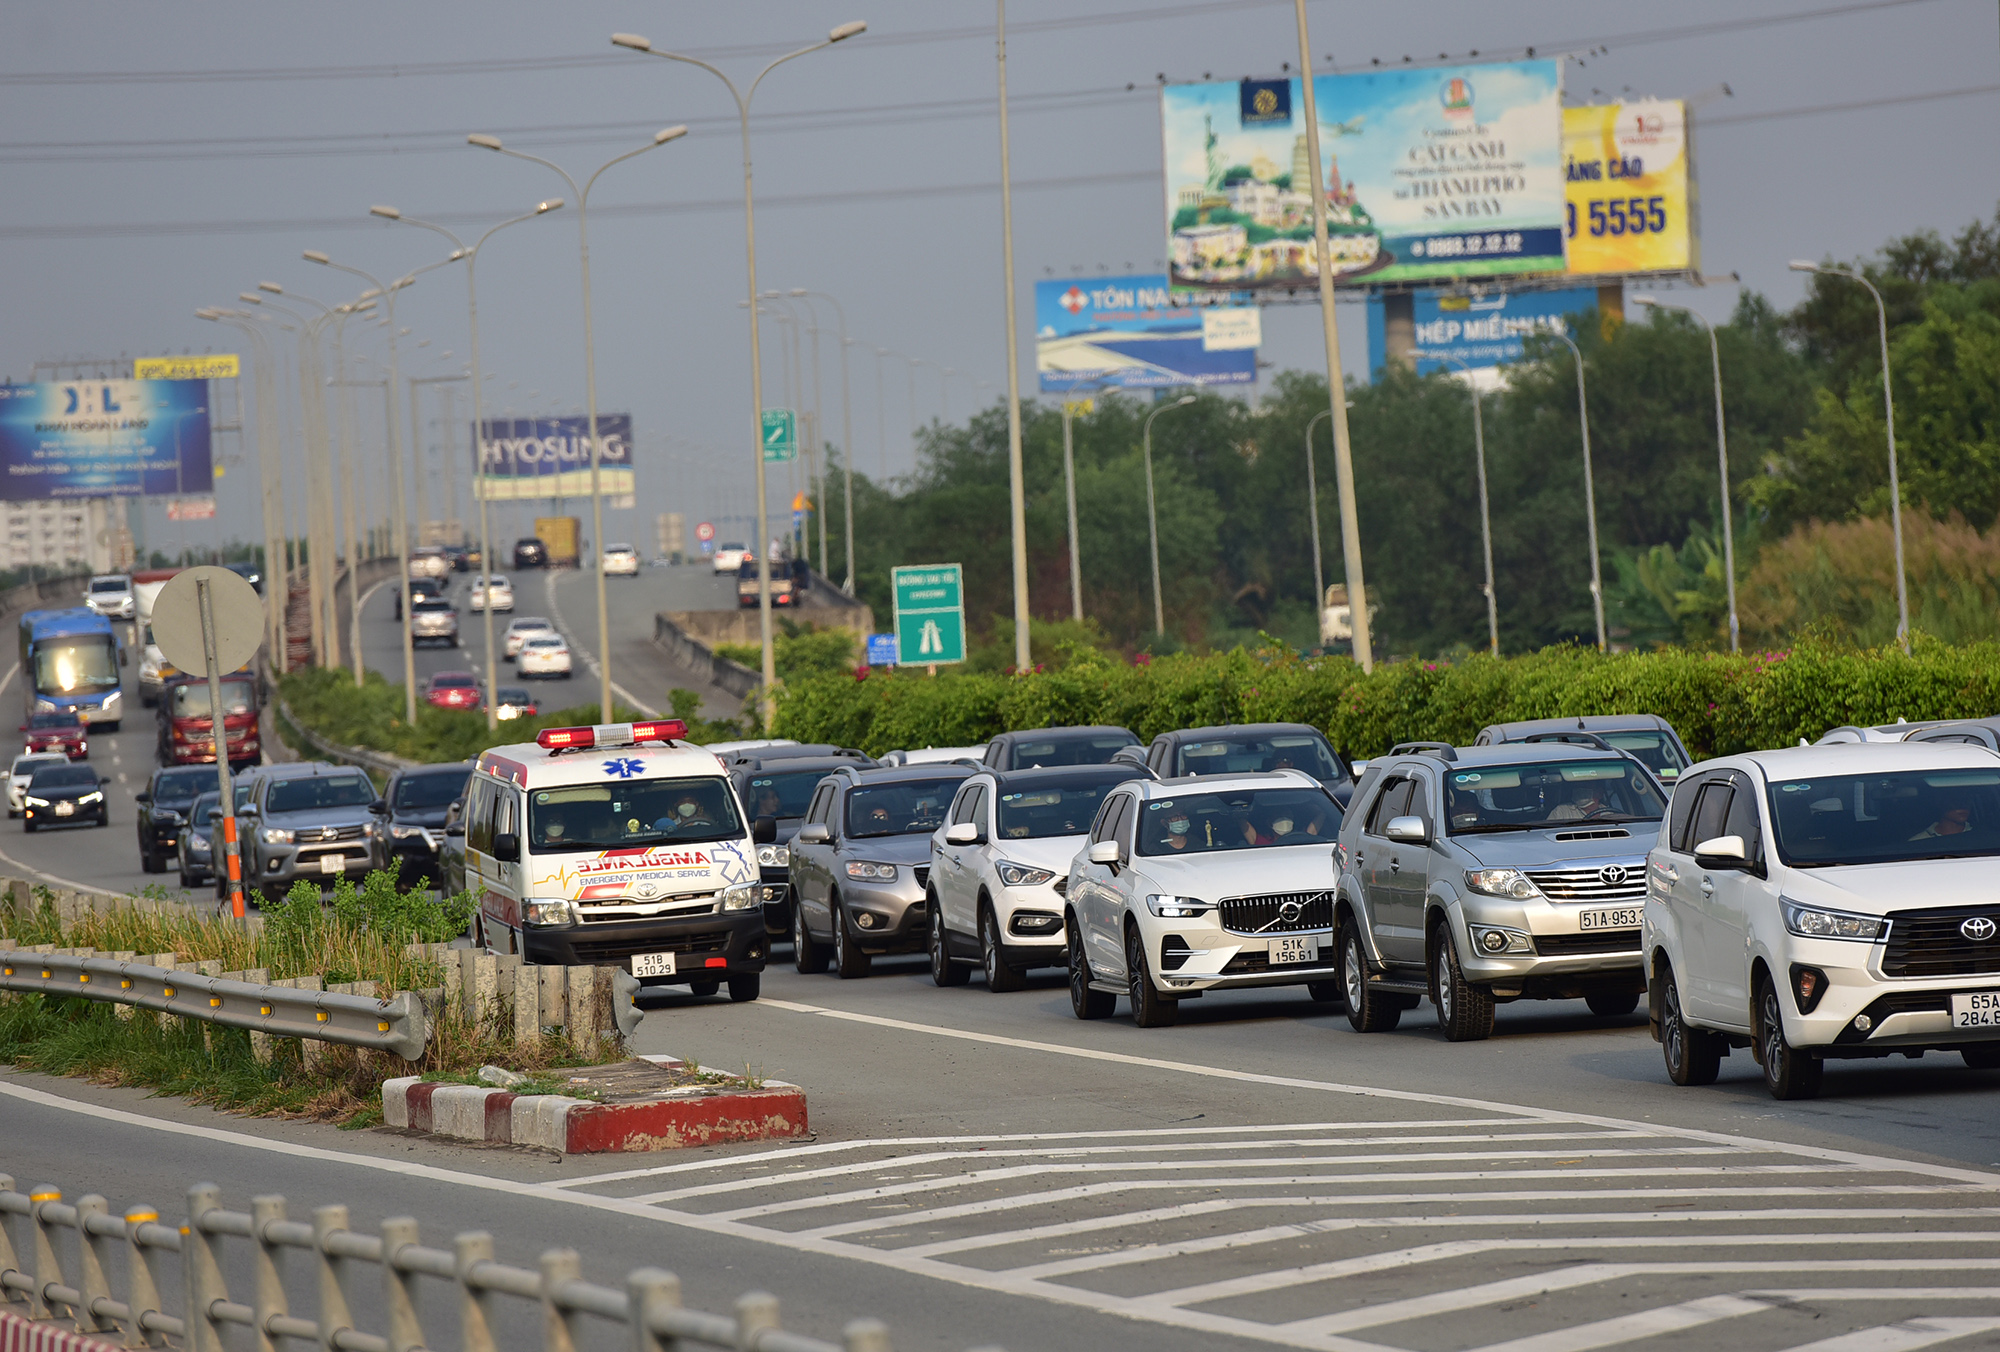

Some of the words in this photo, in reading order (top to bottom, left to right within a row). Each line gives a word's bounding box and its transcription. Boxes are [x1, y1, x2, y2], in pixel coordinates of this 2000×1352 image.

[1588, 196, 1667, 238] 5555
[1090, 285, 1134, 309] TÔN
[480, 433, 626, 464] HYOSUNG
[579, 873, 635, 886] EMERGENCY
[636, 871, 675, 881] MEDICAL
[677, 869, 711, 879] SERVICE
[1282, 938, 1304, 951] 51K
[643, 954, 663, 966] 51B
[1275, 949, 1313, 963] 156.61
[637, 963, 672, 976] 510.29
[1971, 994, 2000, 1009] 65A
